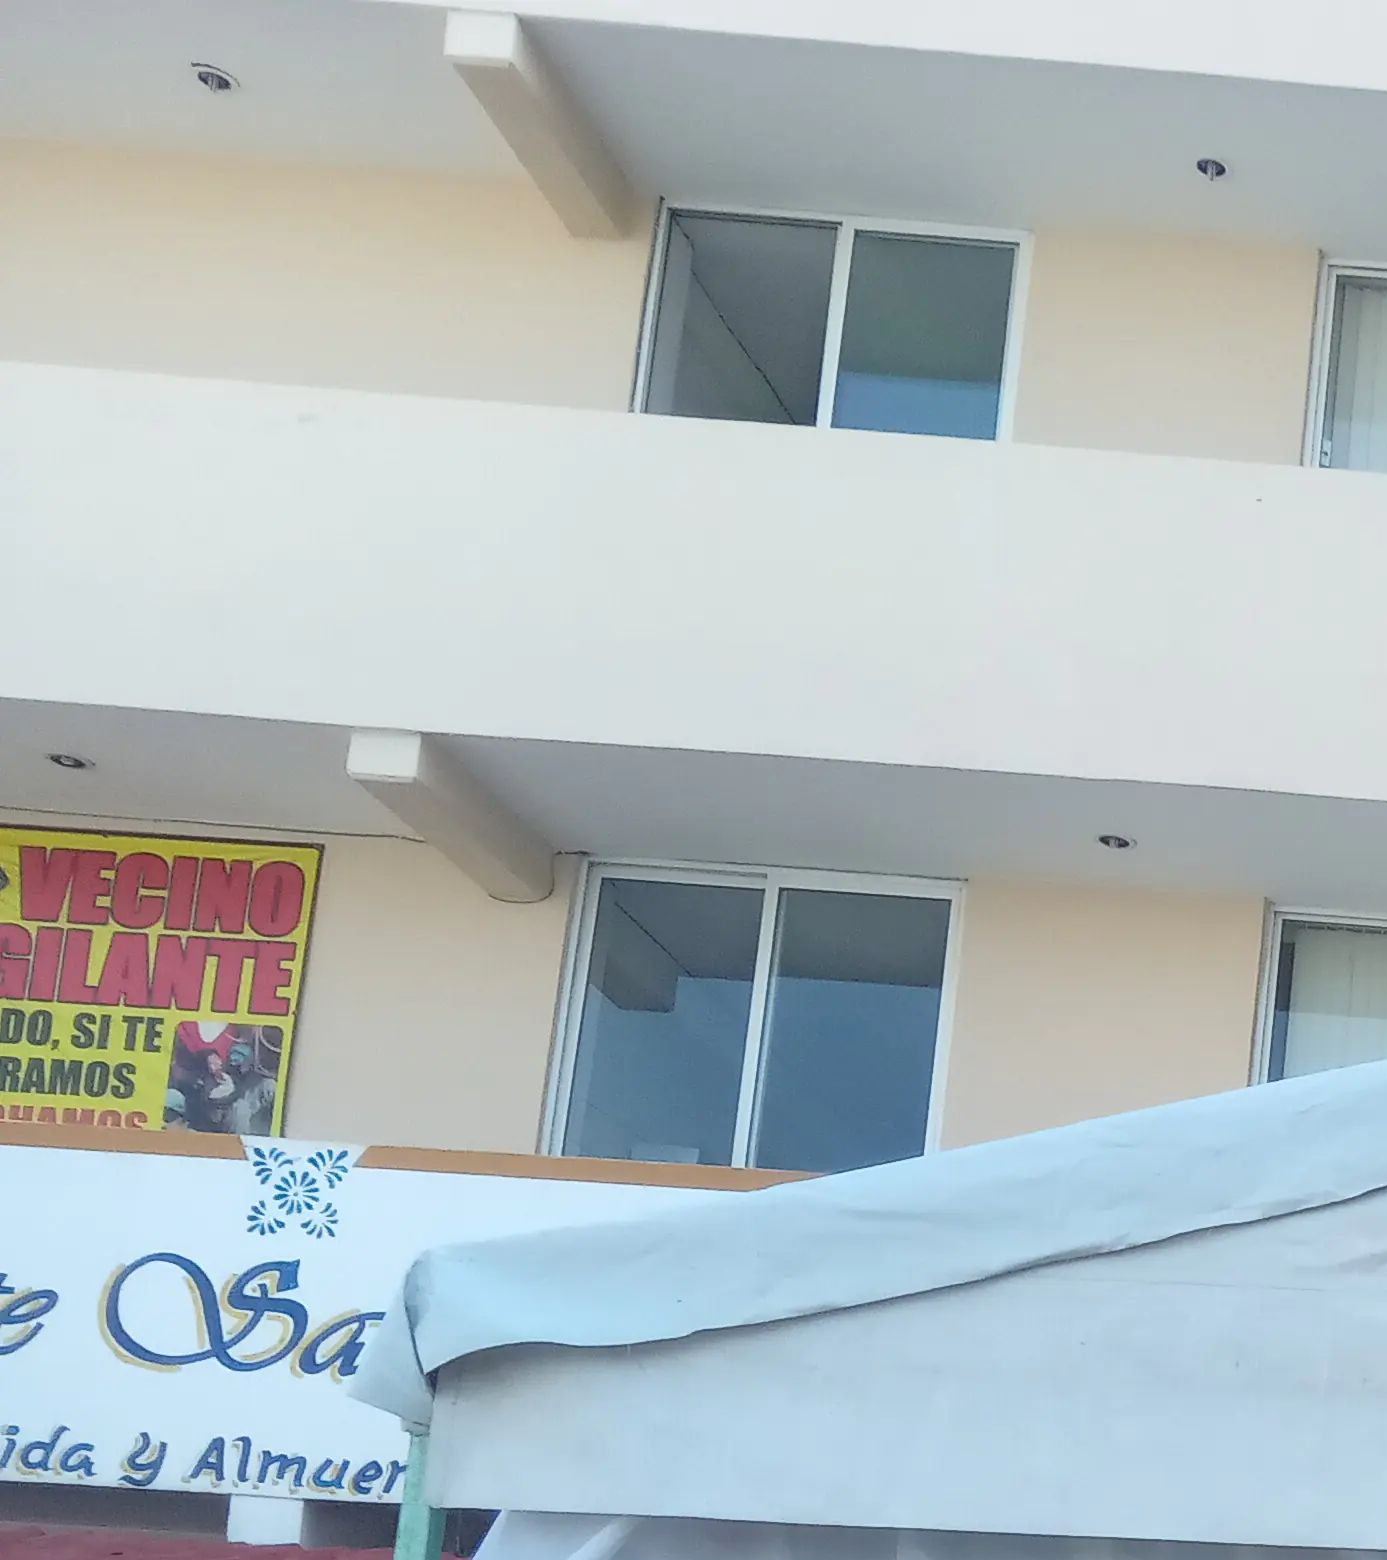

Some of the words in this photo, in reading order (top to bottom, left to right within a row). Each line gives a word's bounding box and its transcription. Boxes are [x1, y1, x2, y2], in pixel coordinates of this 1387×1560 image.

[19, 845, 305, 937] VECINO
[70, 1012, 112, 1050] SI
[121, 1014, 165, 1053] TE
[117, 1431, 168, 1487] y
